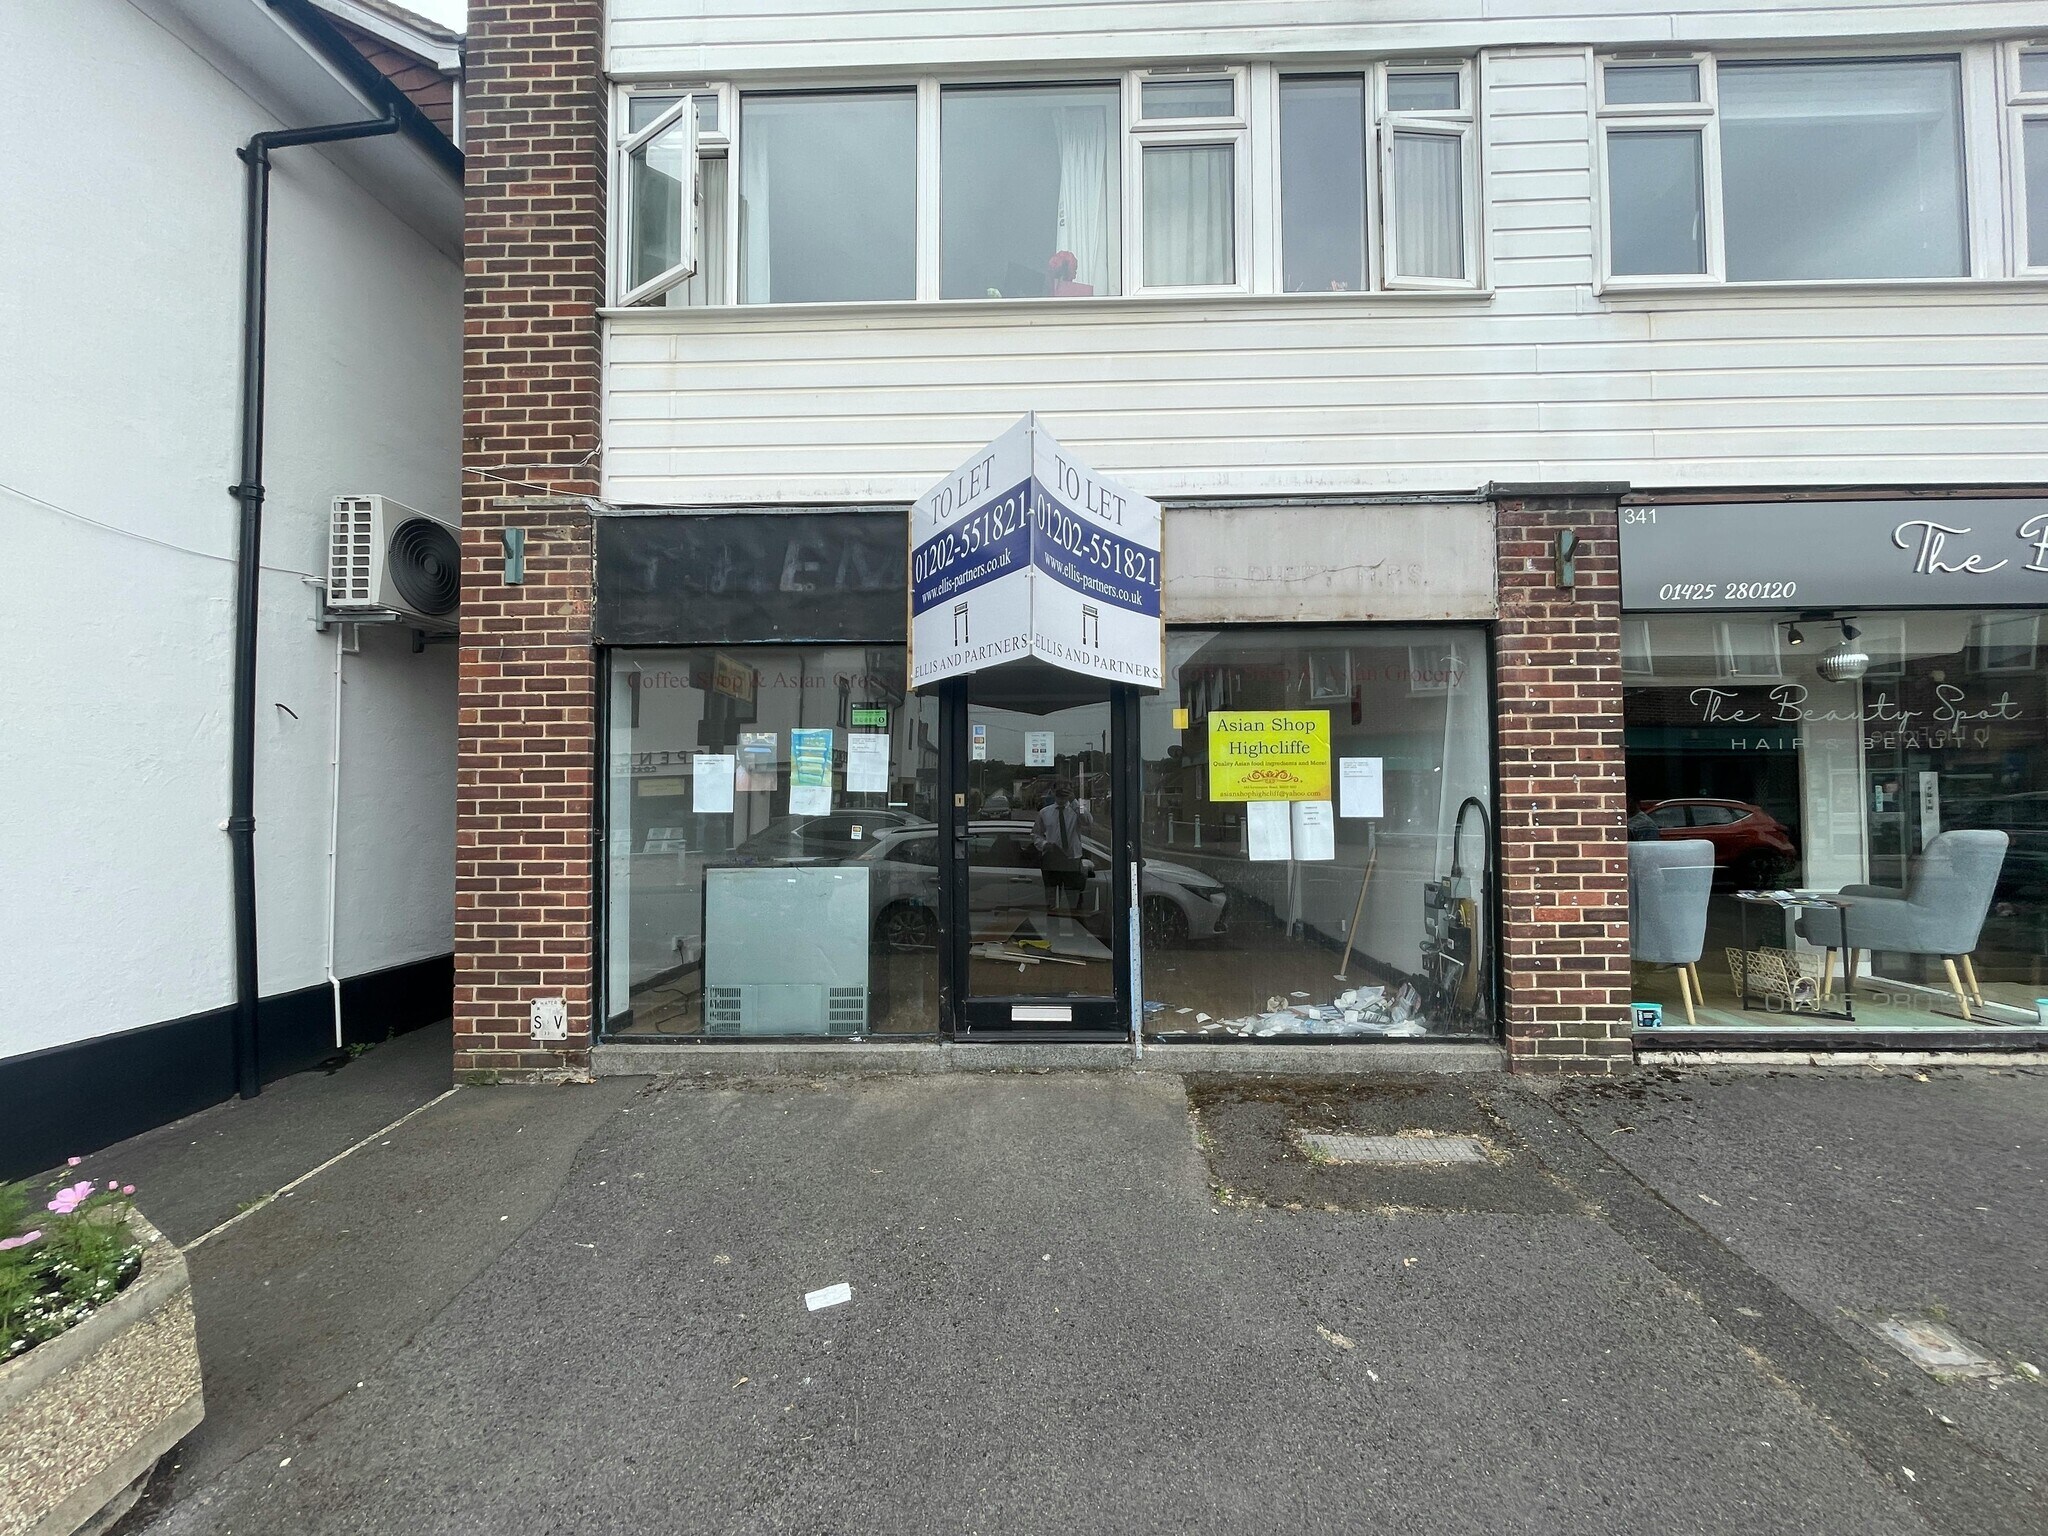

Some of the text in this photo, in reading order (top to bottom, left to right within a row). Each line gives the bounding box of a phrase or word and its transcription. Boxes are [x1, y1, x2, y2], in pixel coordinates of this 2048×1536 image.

[931, 453, 996, 525] TO LET
[1055, 454, 1127, 526] TO LET
[915, 490, 1027, 584] 01202-551821
[1624, 508, 1657, 524] 341
[1037, 493, 1156, 586] 01202-551821
[1894, 520, 2008, 574] The
[922, 548, 1011, 604] www.ellis-partners.co.uk
[1044, 551, 1143, 606] www.ellis-partners.co.uk
[1659, 581, 1797, 600] 01425 280120
[915, 633, 1028, 678] ELLIS AND PARTNERS
[1035, 633, 1160, 680] ELLIS AND PARTNERS
[1385, 664, 1465, 687] Grocery
[627, 671, 690, 688] Coffee
[1217, 718, 1316, 735] Asian Shop
[1690, 684, 2024, 733] The Beauty Spot
[1229, 740, 1311, 759] Highcliffe
[1731, 738, 1809, 750] HAIR
[1863, 737, 1990, 749] BEAUTY
[534, 1015, 563, 1030] S V
